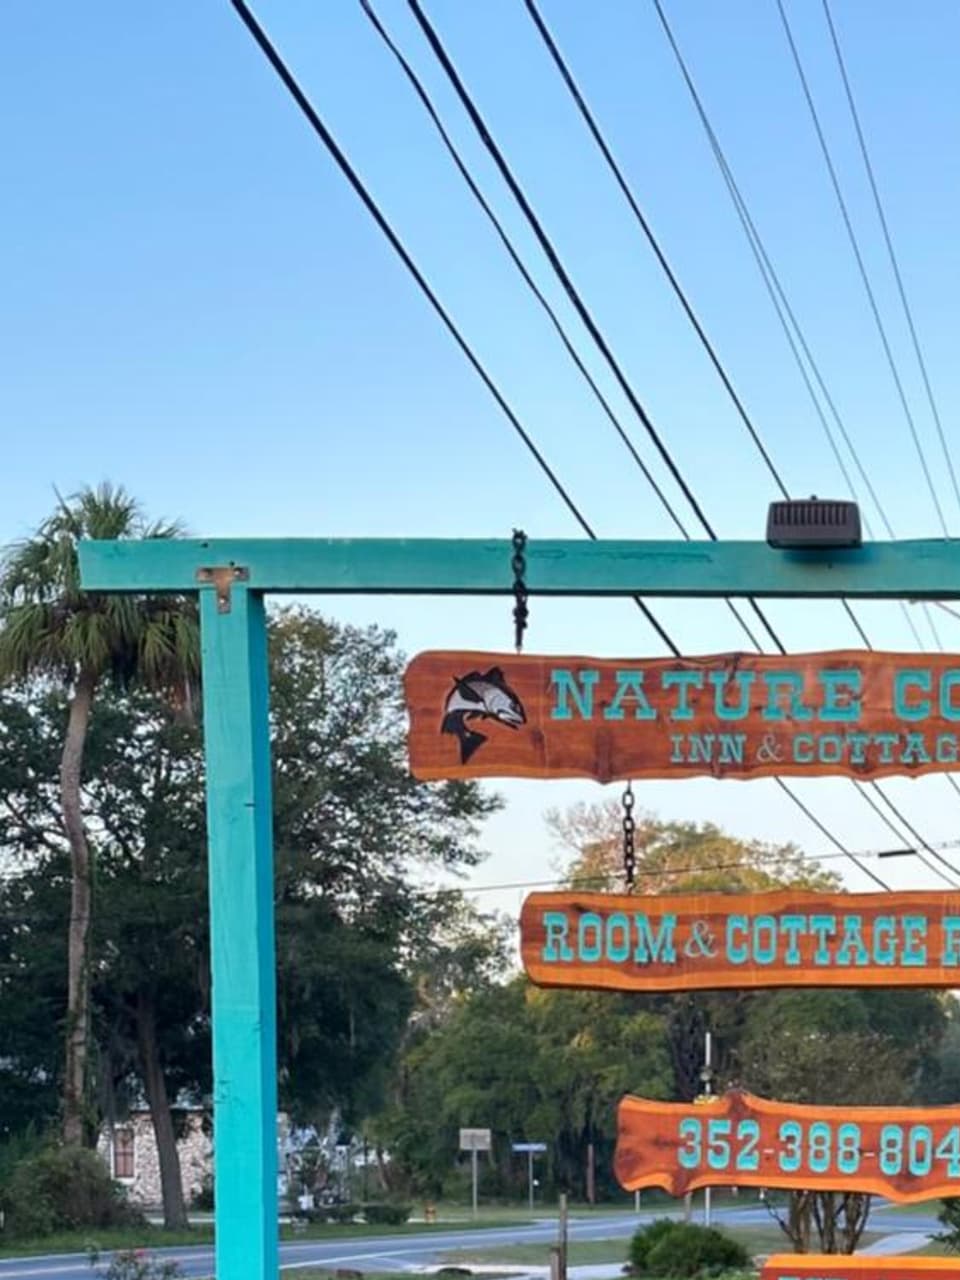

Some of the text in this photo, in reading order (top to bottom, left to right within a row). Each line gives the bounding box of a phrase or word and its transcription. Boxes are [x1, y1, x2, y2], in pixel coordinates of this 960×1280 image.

[549, 668, 863, 722] NATURE
[670, 733, 747, 764] INN
[756, 734, 784, 763] &
[541, 911, 678, 963] ROOM
[684, 919, 719, 958] &
[726, 914, 928, 966] COTTAGE
